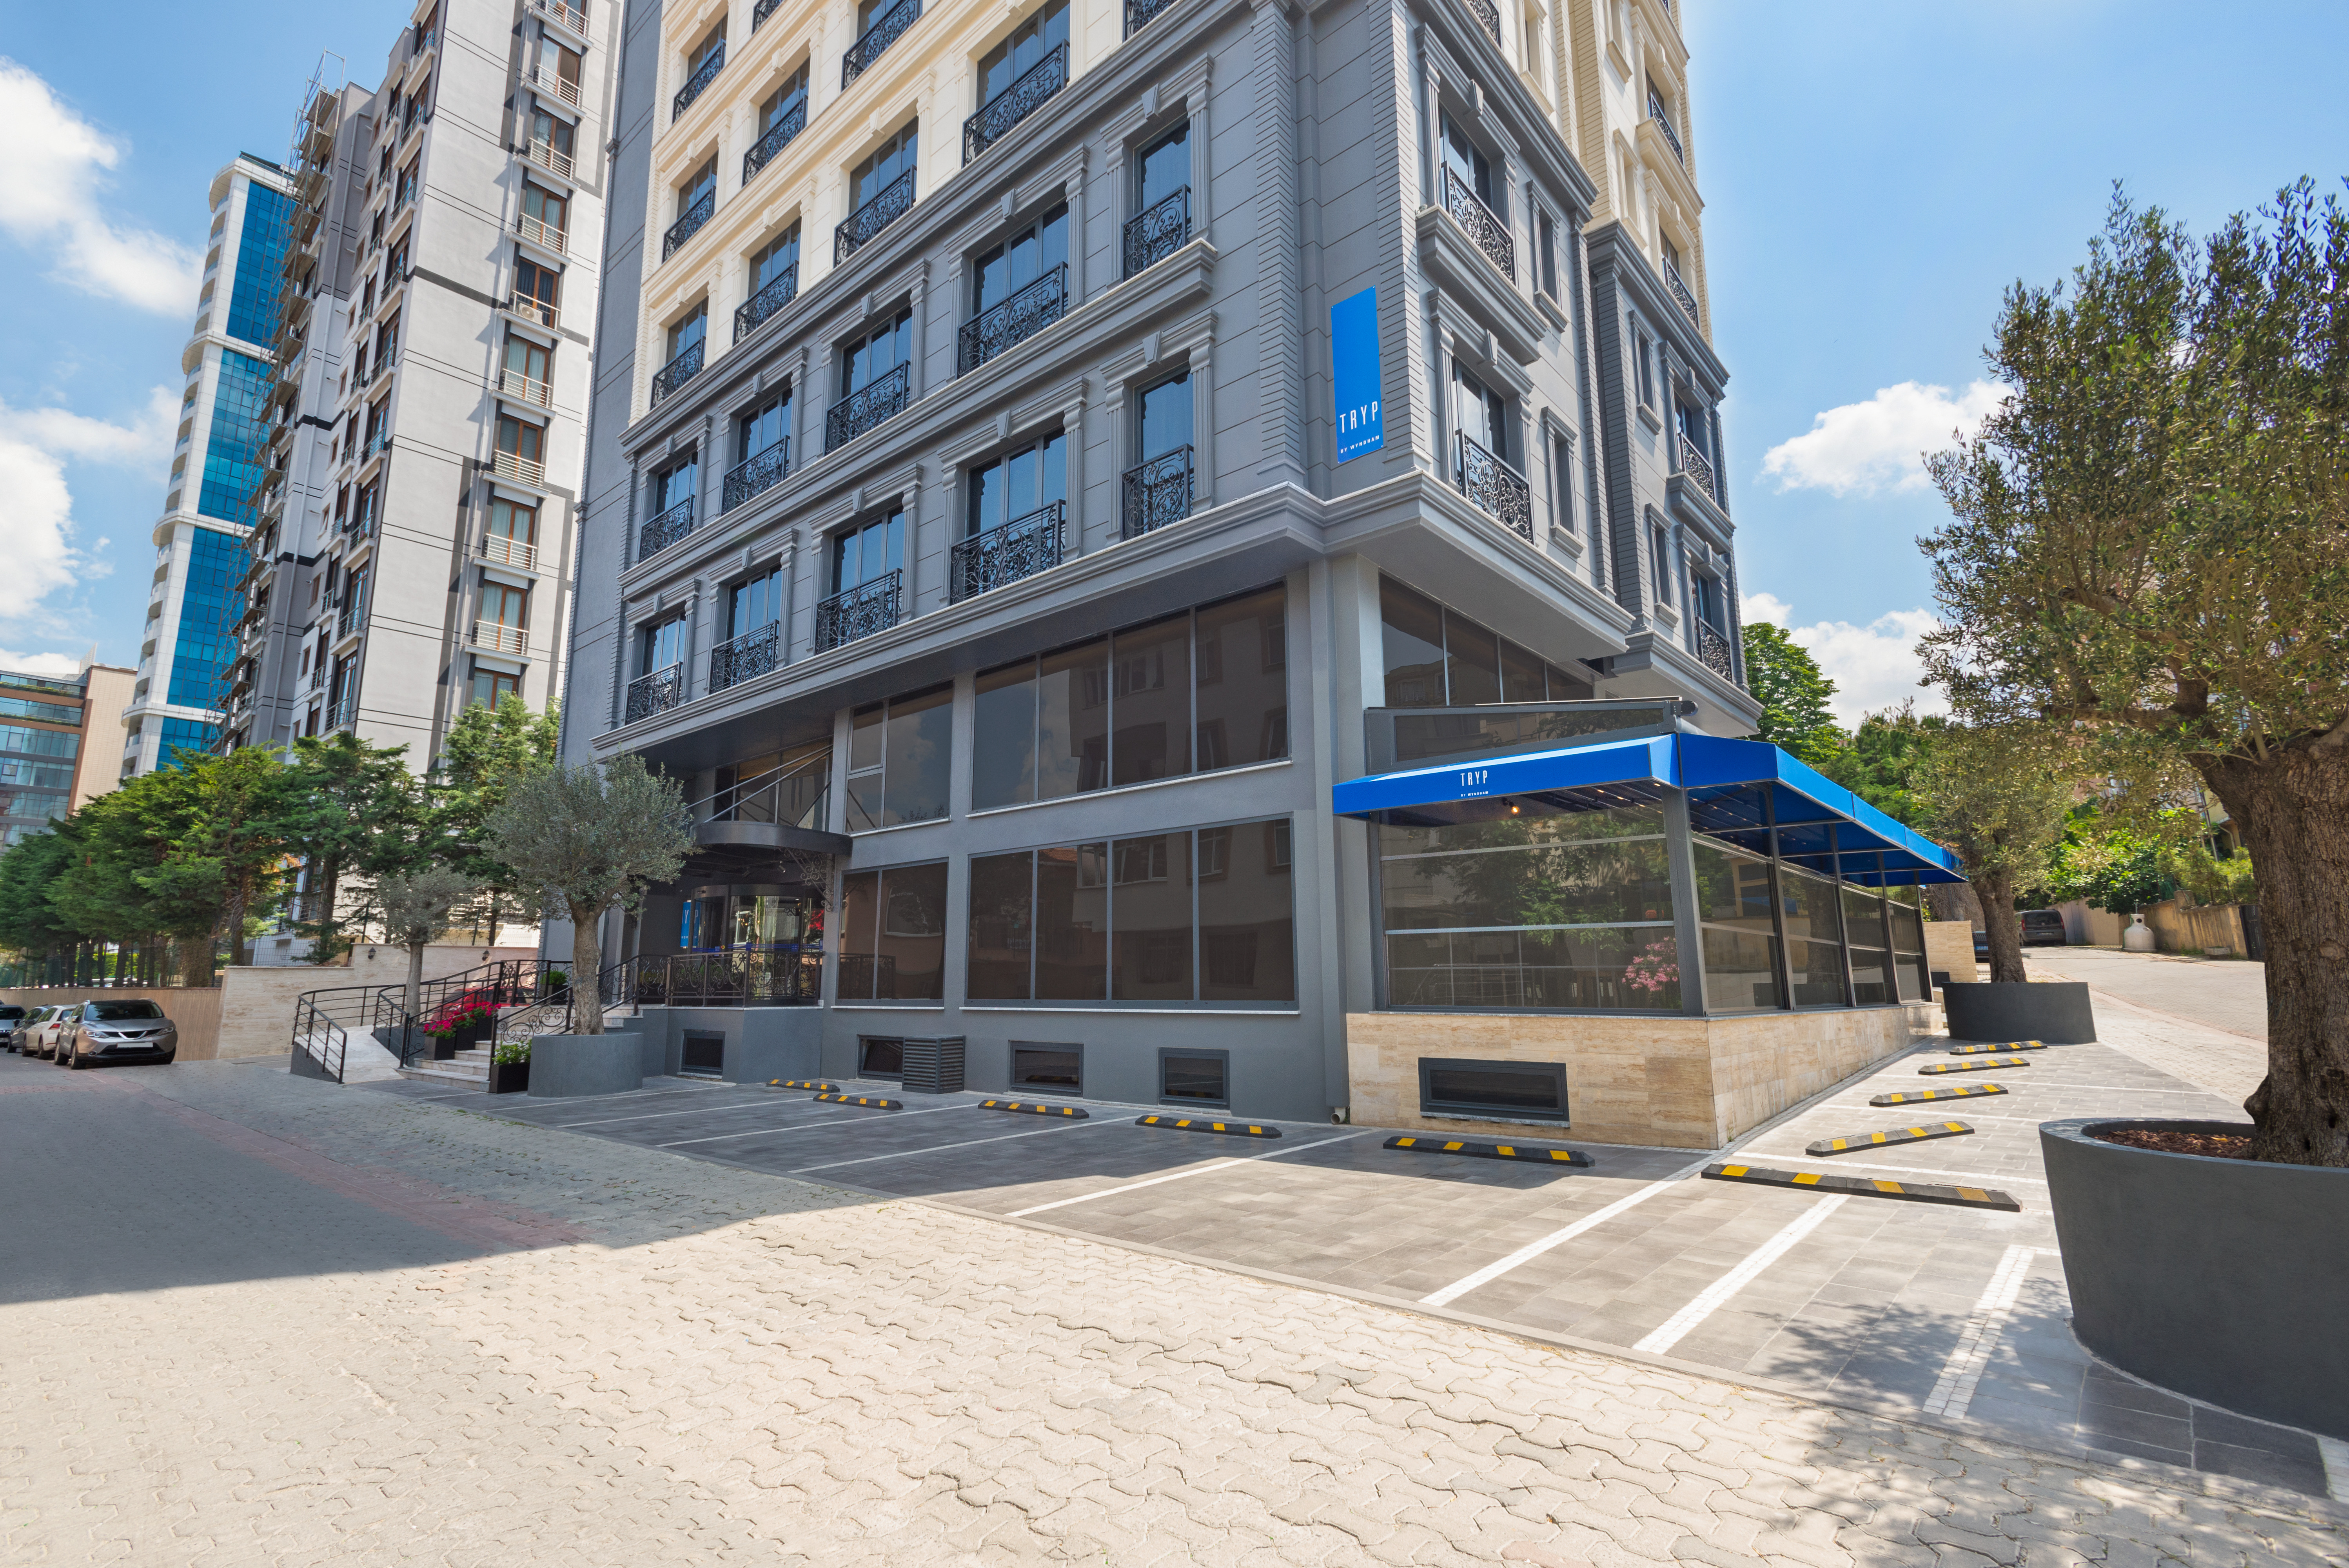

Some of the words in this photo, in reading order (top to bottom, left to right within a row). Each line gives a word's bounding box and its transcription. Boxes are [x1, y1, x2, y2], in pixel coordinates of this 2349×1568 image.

[1340, 401, 1378, 433] TRYP
[1350, 435, 1380, 450] WYNDHAM
[1460, 770, 1488, 786] TRYP
